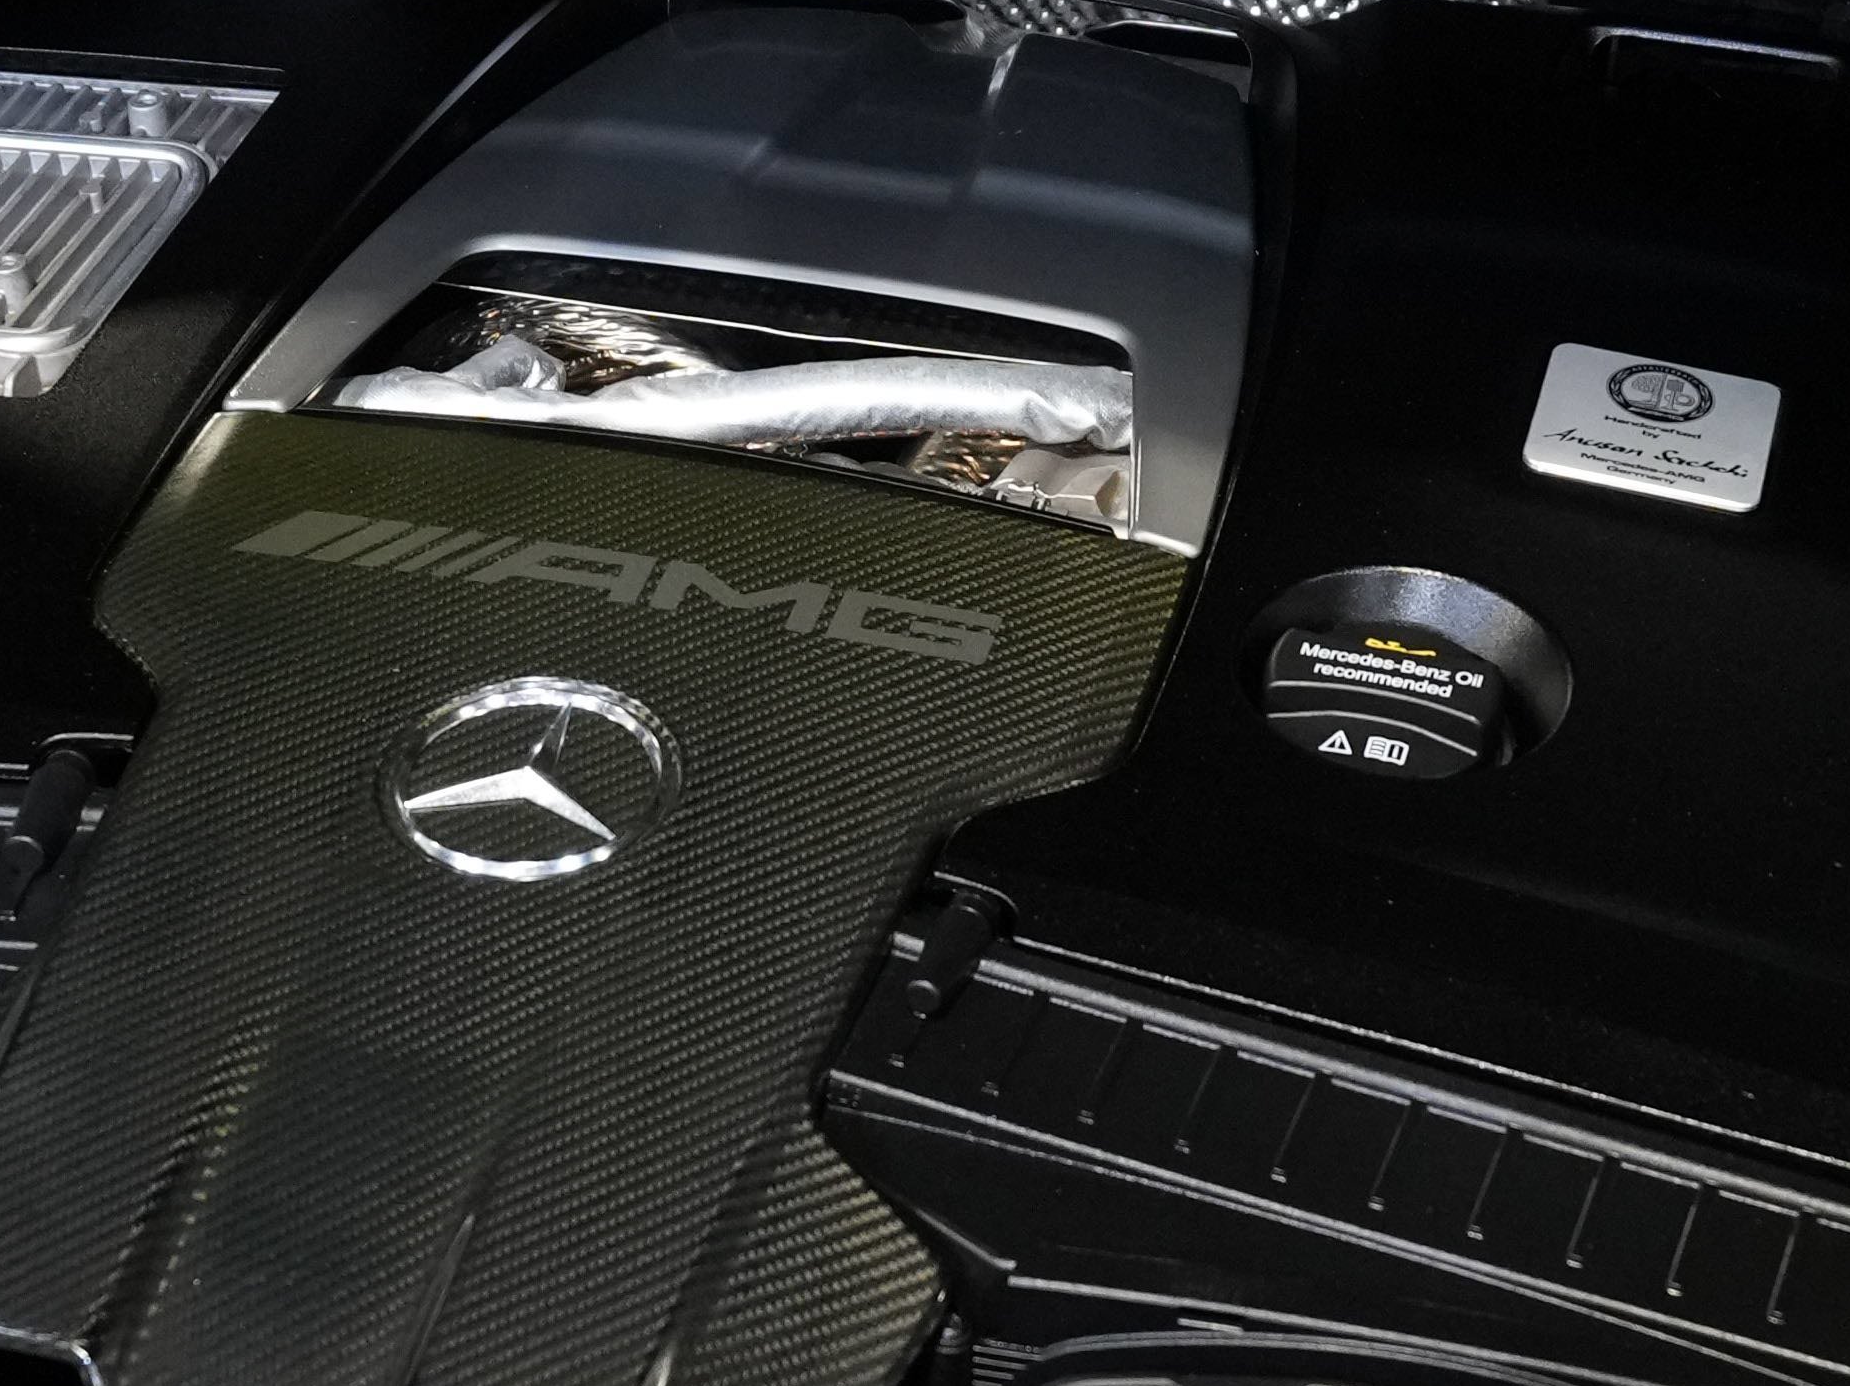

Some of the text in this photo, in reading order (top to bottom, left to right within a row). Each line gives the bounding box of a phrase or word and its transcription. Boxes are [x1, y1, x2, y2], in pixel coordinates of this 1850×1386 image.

[1604, 415, 1702, 439] Handcrafted
[1642, 429, 1661, 440] by
[1581, 452, 1705, 483] Mercedes-AMG
[1606, 465, 1677, 485] Germany
[465, 541, 1002, 665] AMG
[1299, 641, 1485, 689] Mercedes-Benz Oil
[1312, 662, 1453, 698] recommended
